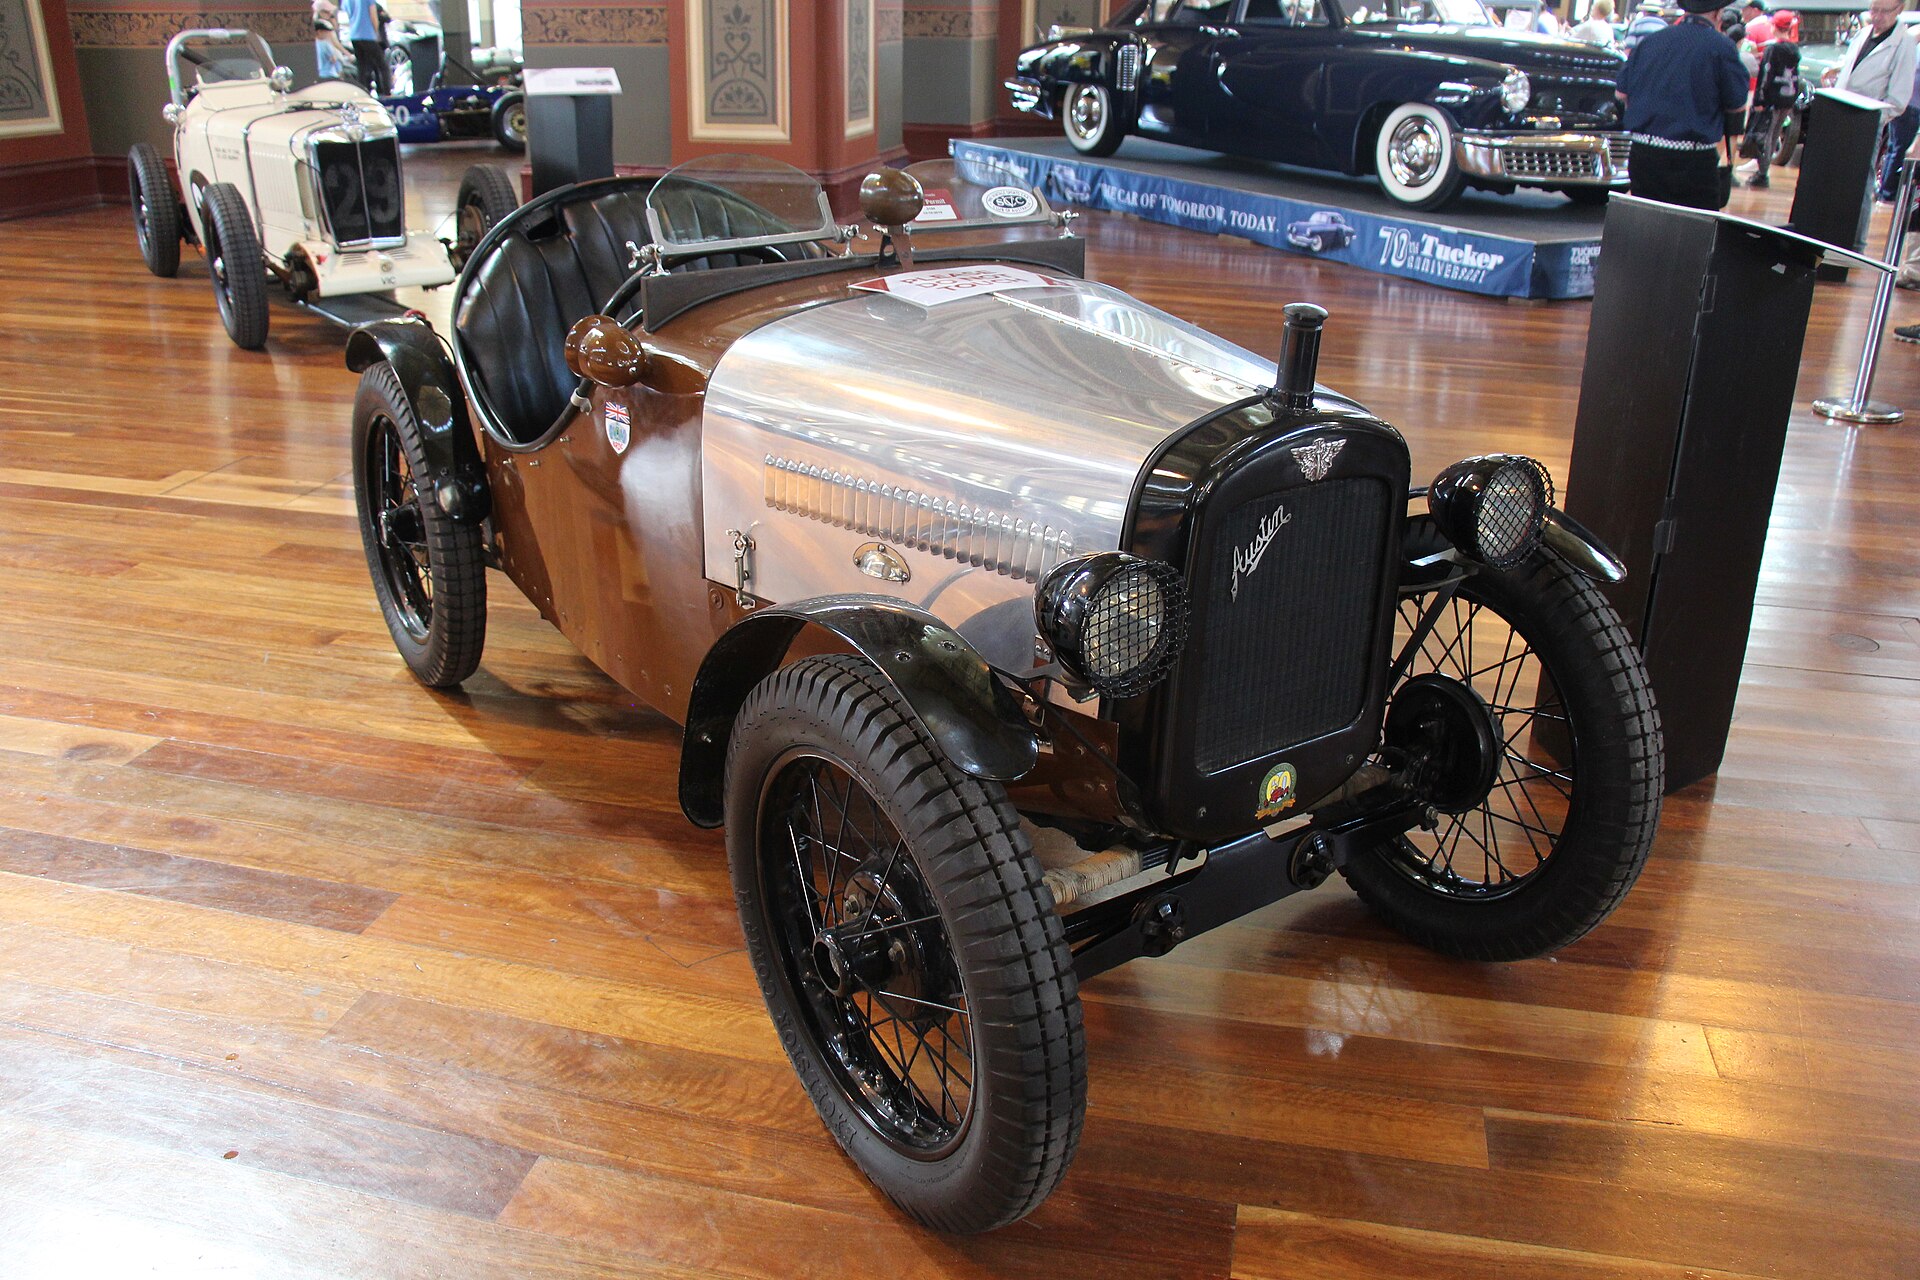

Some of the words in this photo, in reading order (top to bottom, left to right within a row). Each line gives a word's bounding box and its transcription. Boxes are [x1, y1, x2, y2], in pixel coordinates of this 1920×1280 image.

[324, 158, 401, 227] 29
[1117, 188, 1138, 207] CAR
[1139, 193, 1158, 209] OF
[1159, 194, 1227, 225] TOMORROW,
[1230, 209, 1280, 233] TODAY.
[1421, 233, 1505, 271] Tucker
[1571, 246, 1602, 258] TUCKE
[900, 269, 997, 284] PLEASE
[916, 279, 957, 289] DO
[959, 273, 1012, 282] NOT
[936, 277, 1030, 291] TOUCH
[1230, 505, 1292, 603] Austin
